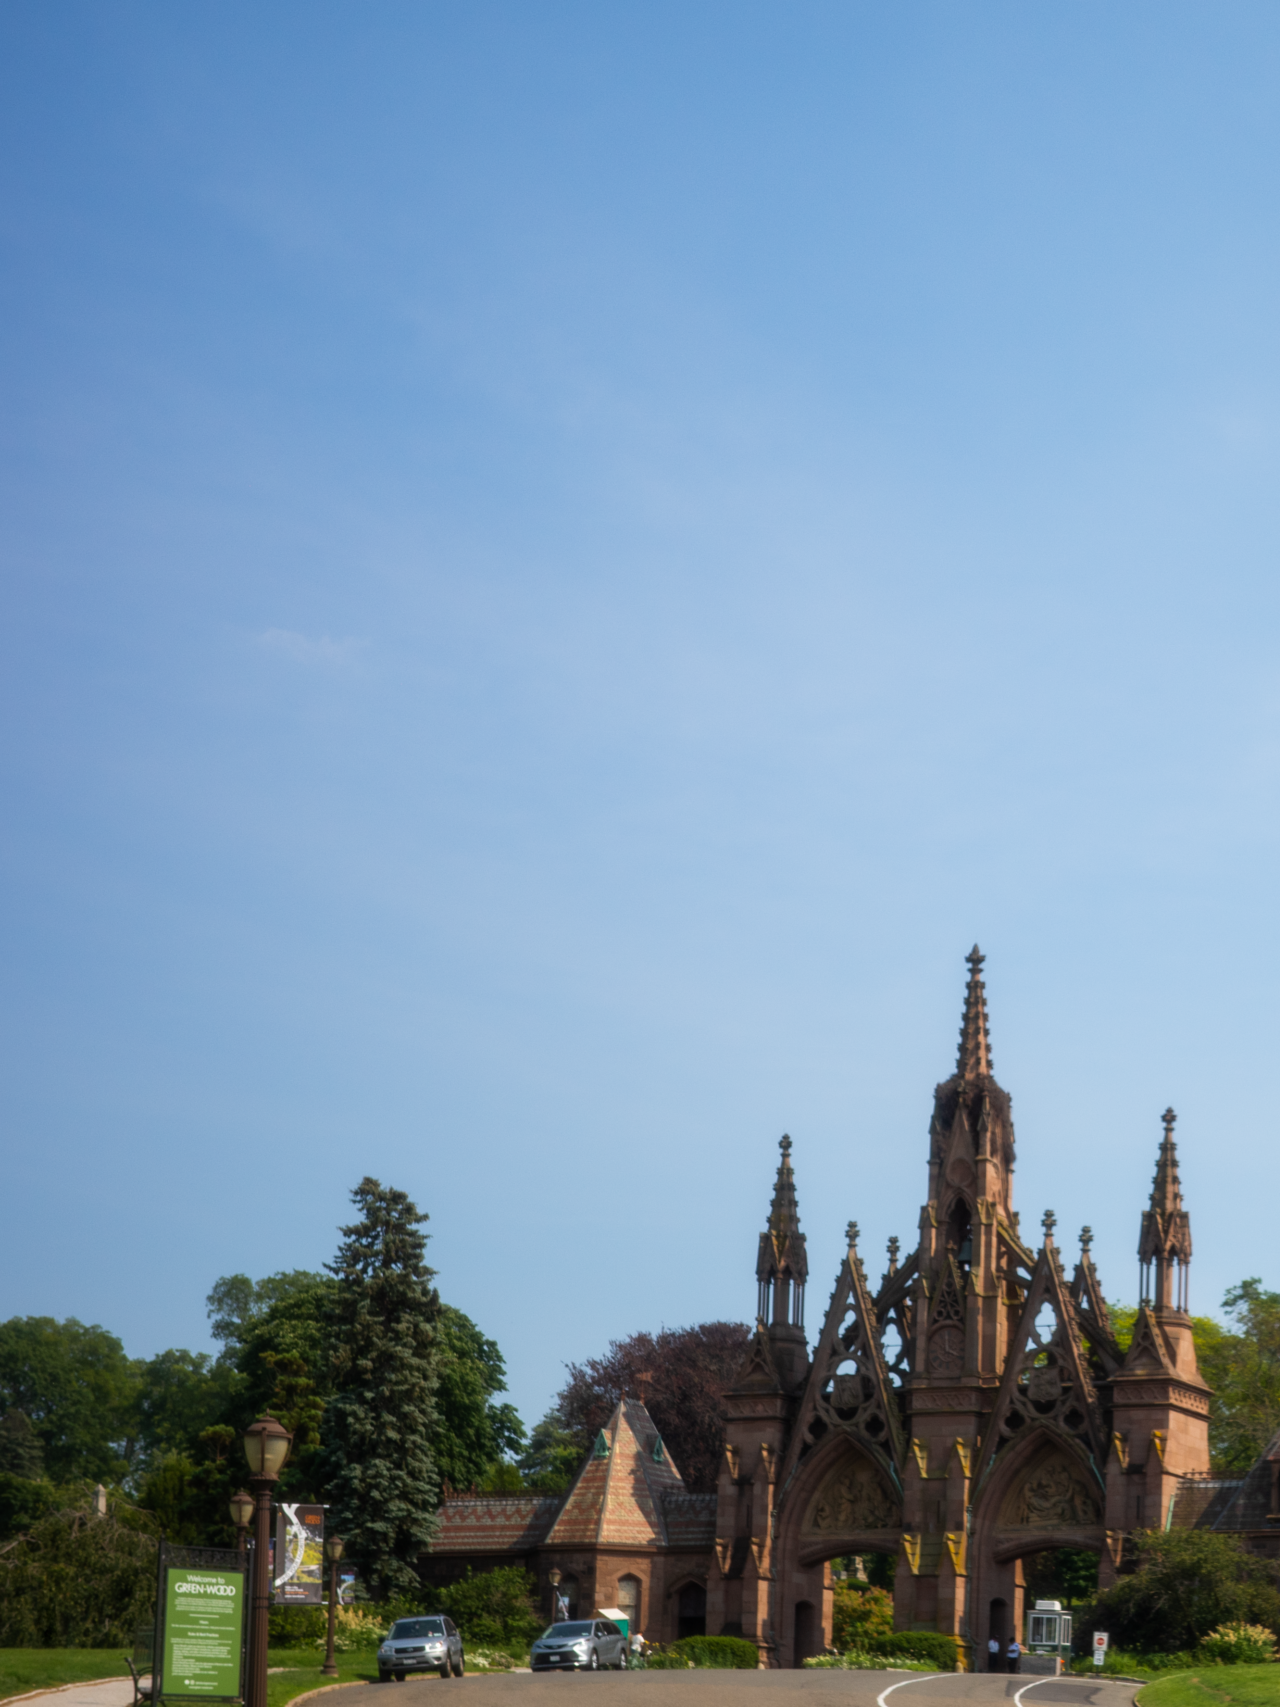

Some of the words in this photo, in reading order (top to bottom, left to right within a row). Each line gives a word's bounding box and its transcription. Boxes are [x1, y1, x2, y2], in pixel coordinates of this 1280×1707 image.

[186, 1574, 217, 1584] Welcome
[217, 1576, 225, 1584] to
[175, 1582, 236, 1596] GREEN-WOOD
